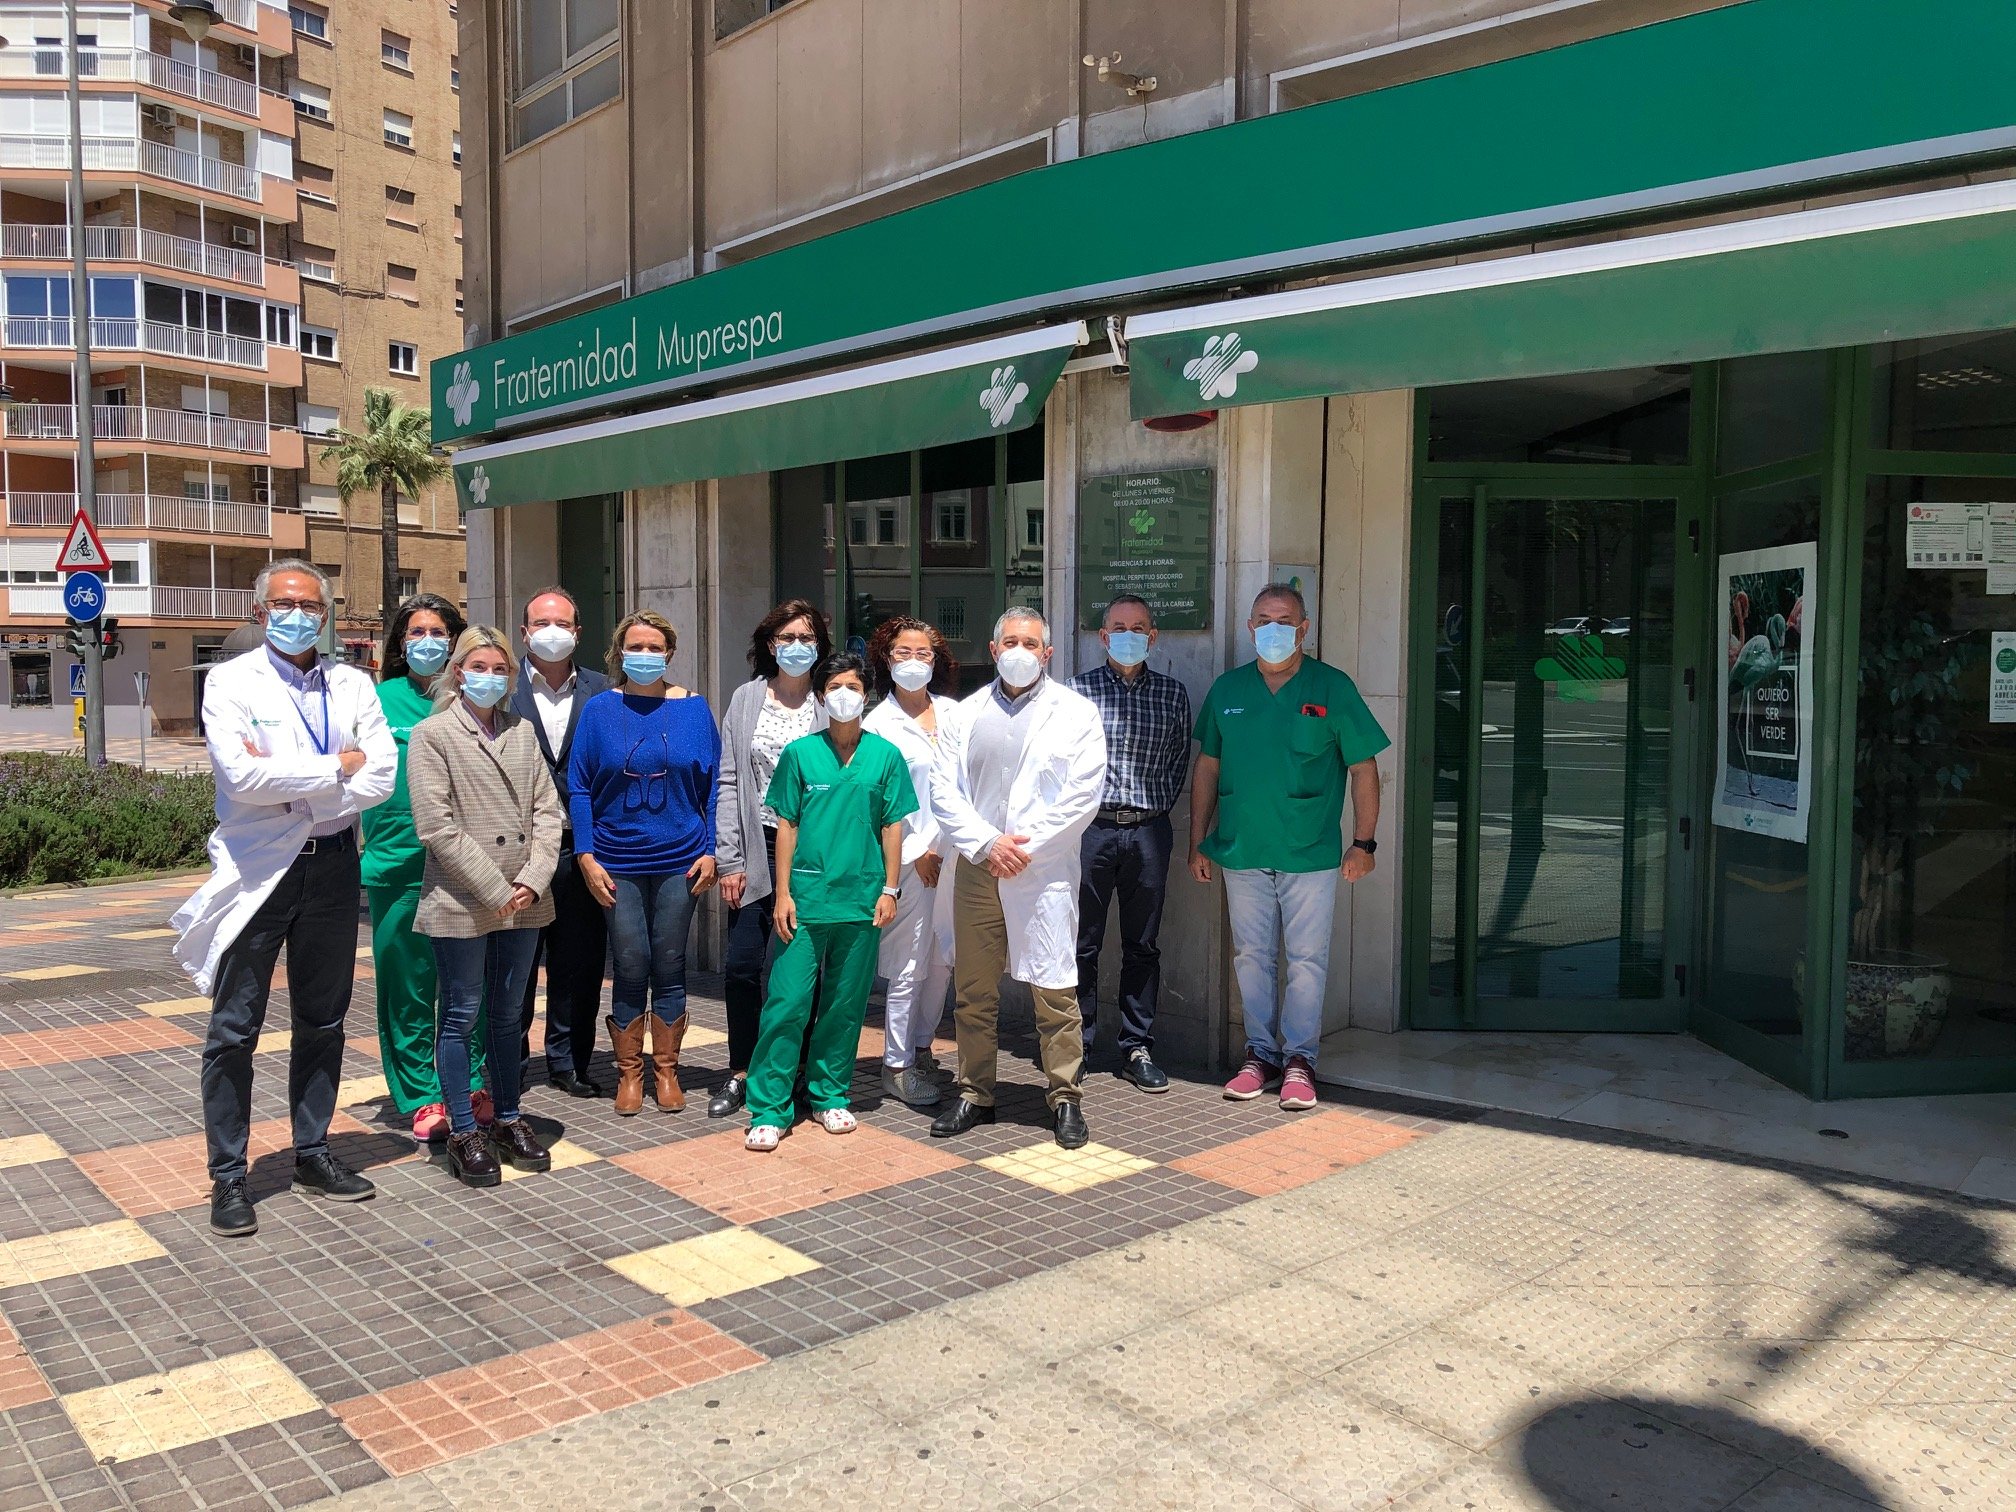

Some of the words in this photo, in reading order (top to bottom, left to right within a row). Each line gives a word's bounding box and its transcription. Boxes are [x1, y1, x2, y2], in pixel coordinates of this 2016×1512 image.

[494, 317, 637, 410] Fraternidad
[657, 310, 783, 372] Muprespa
[1126, 477, 1162, 487] HORARIO:
[1149, 487, 1176, 495] VIERNES
[1151, 497, 1174, 505] HORAS
[1109, 559, 1144, 567] URGENCIAS
[1152, 558, 1176, 566] HORAS:
[1091, 601, 1110, 609] CENTR
[1757, 688, 1790, 702] QUIERO
[1765, 707, 1780, 721] SER
[1760, 725, 1786, 741] VERDE
